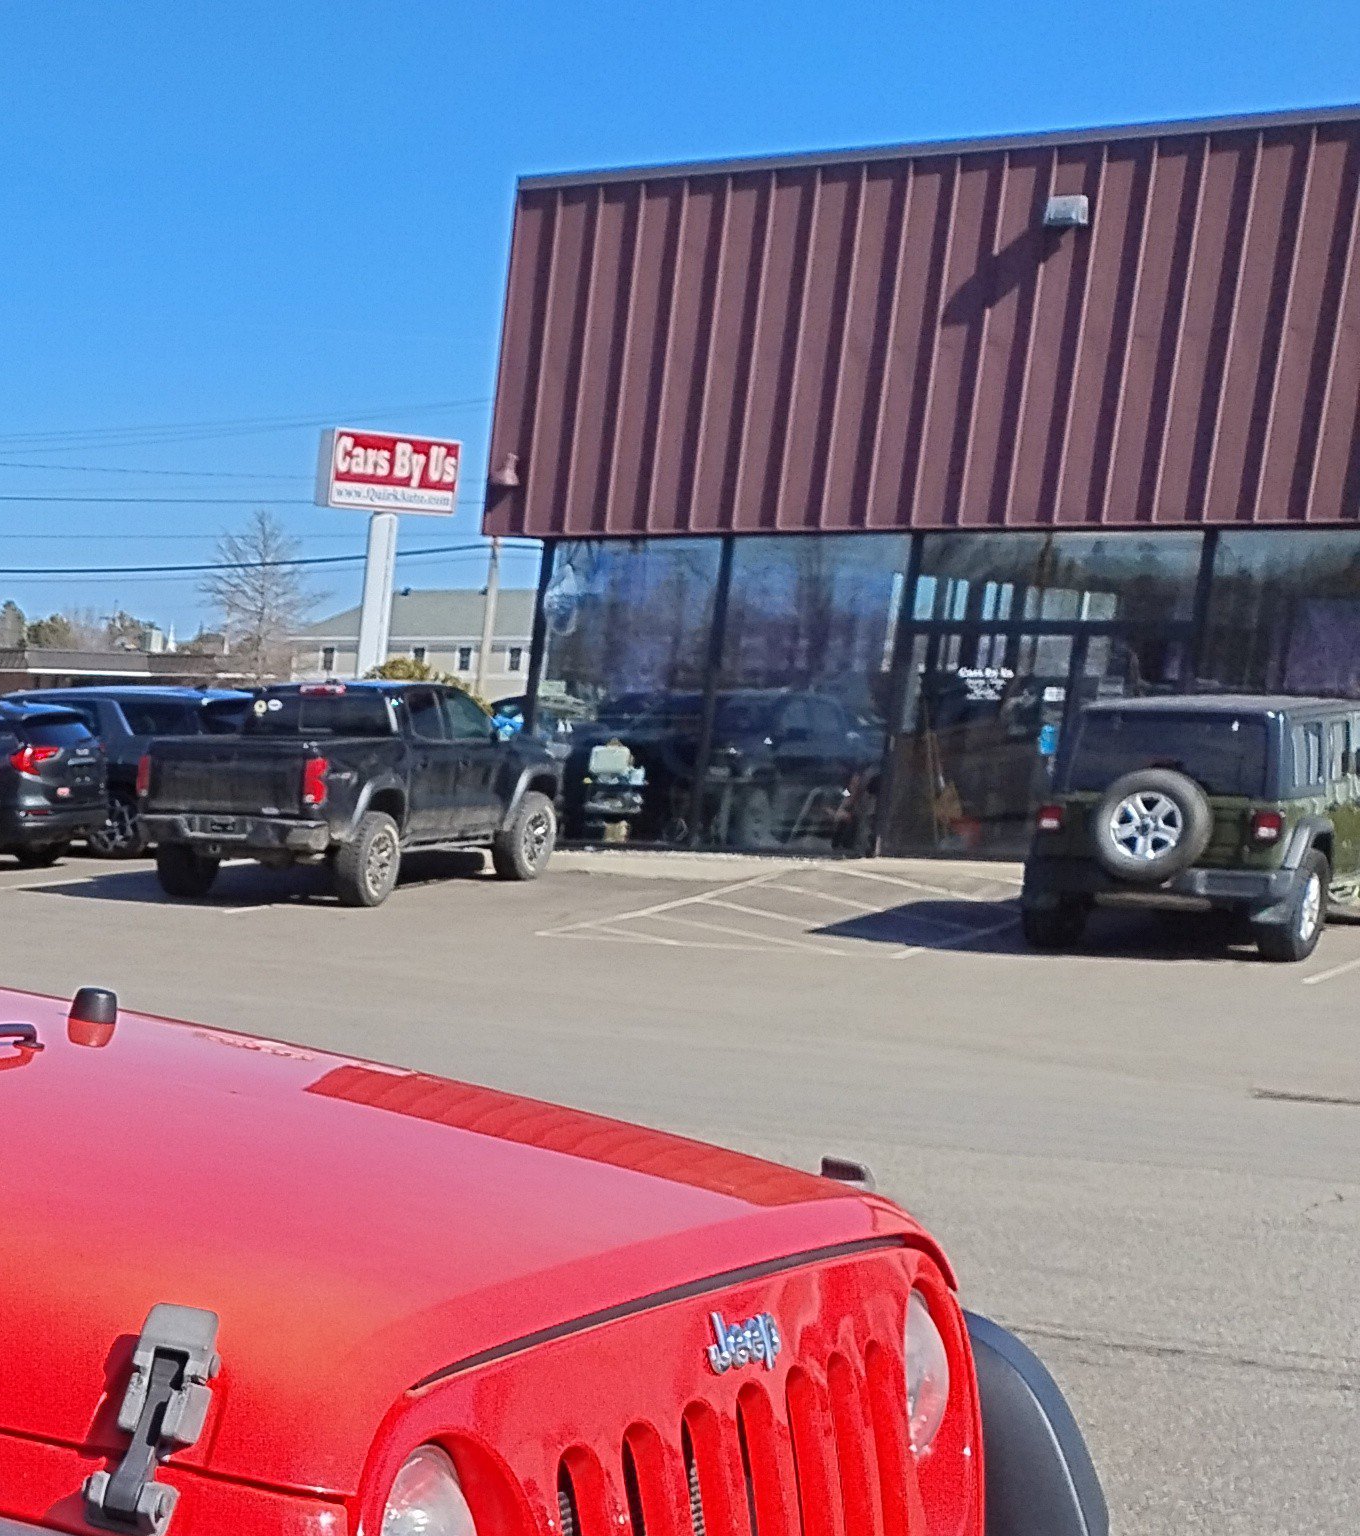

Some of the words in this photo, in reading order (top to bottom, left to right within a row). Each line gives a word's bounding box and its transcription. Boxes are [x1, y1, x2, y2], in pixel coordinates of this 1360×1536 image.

[336, 435, 391, 476] Cars
[393, 442, 426, 488] By
[428, 445, 457, 483] Us
[707, 1311, 781, 1374] Jeep
